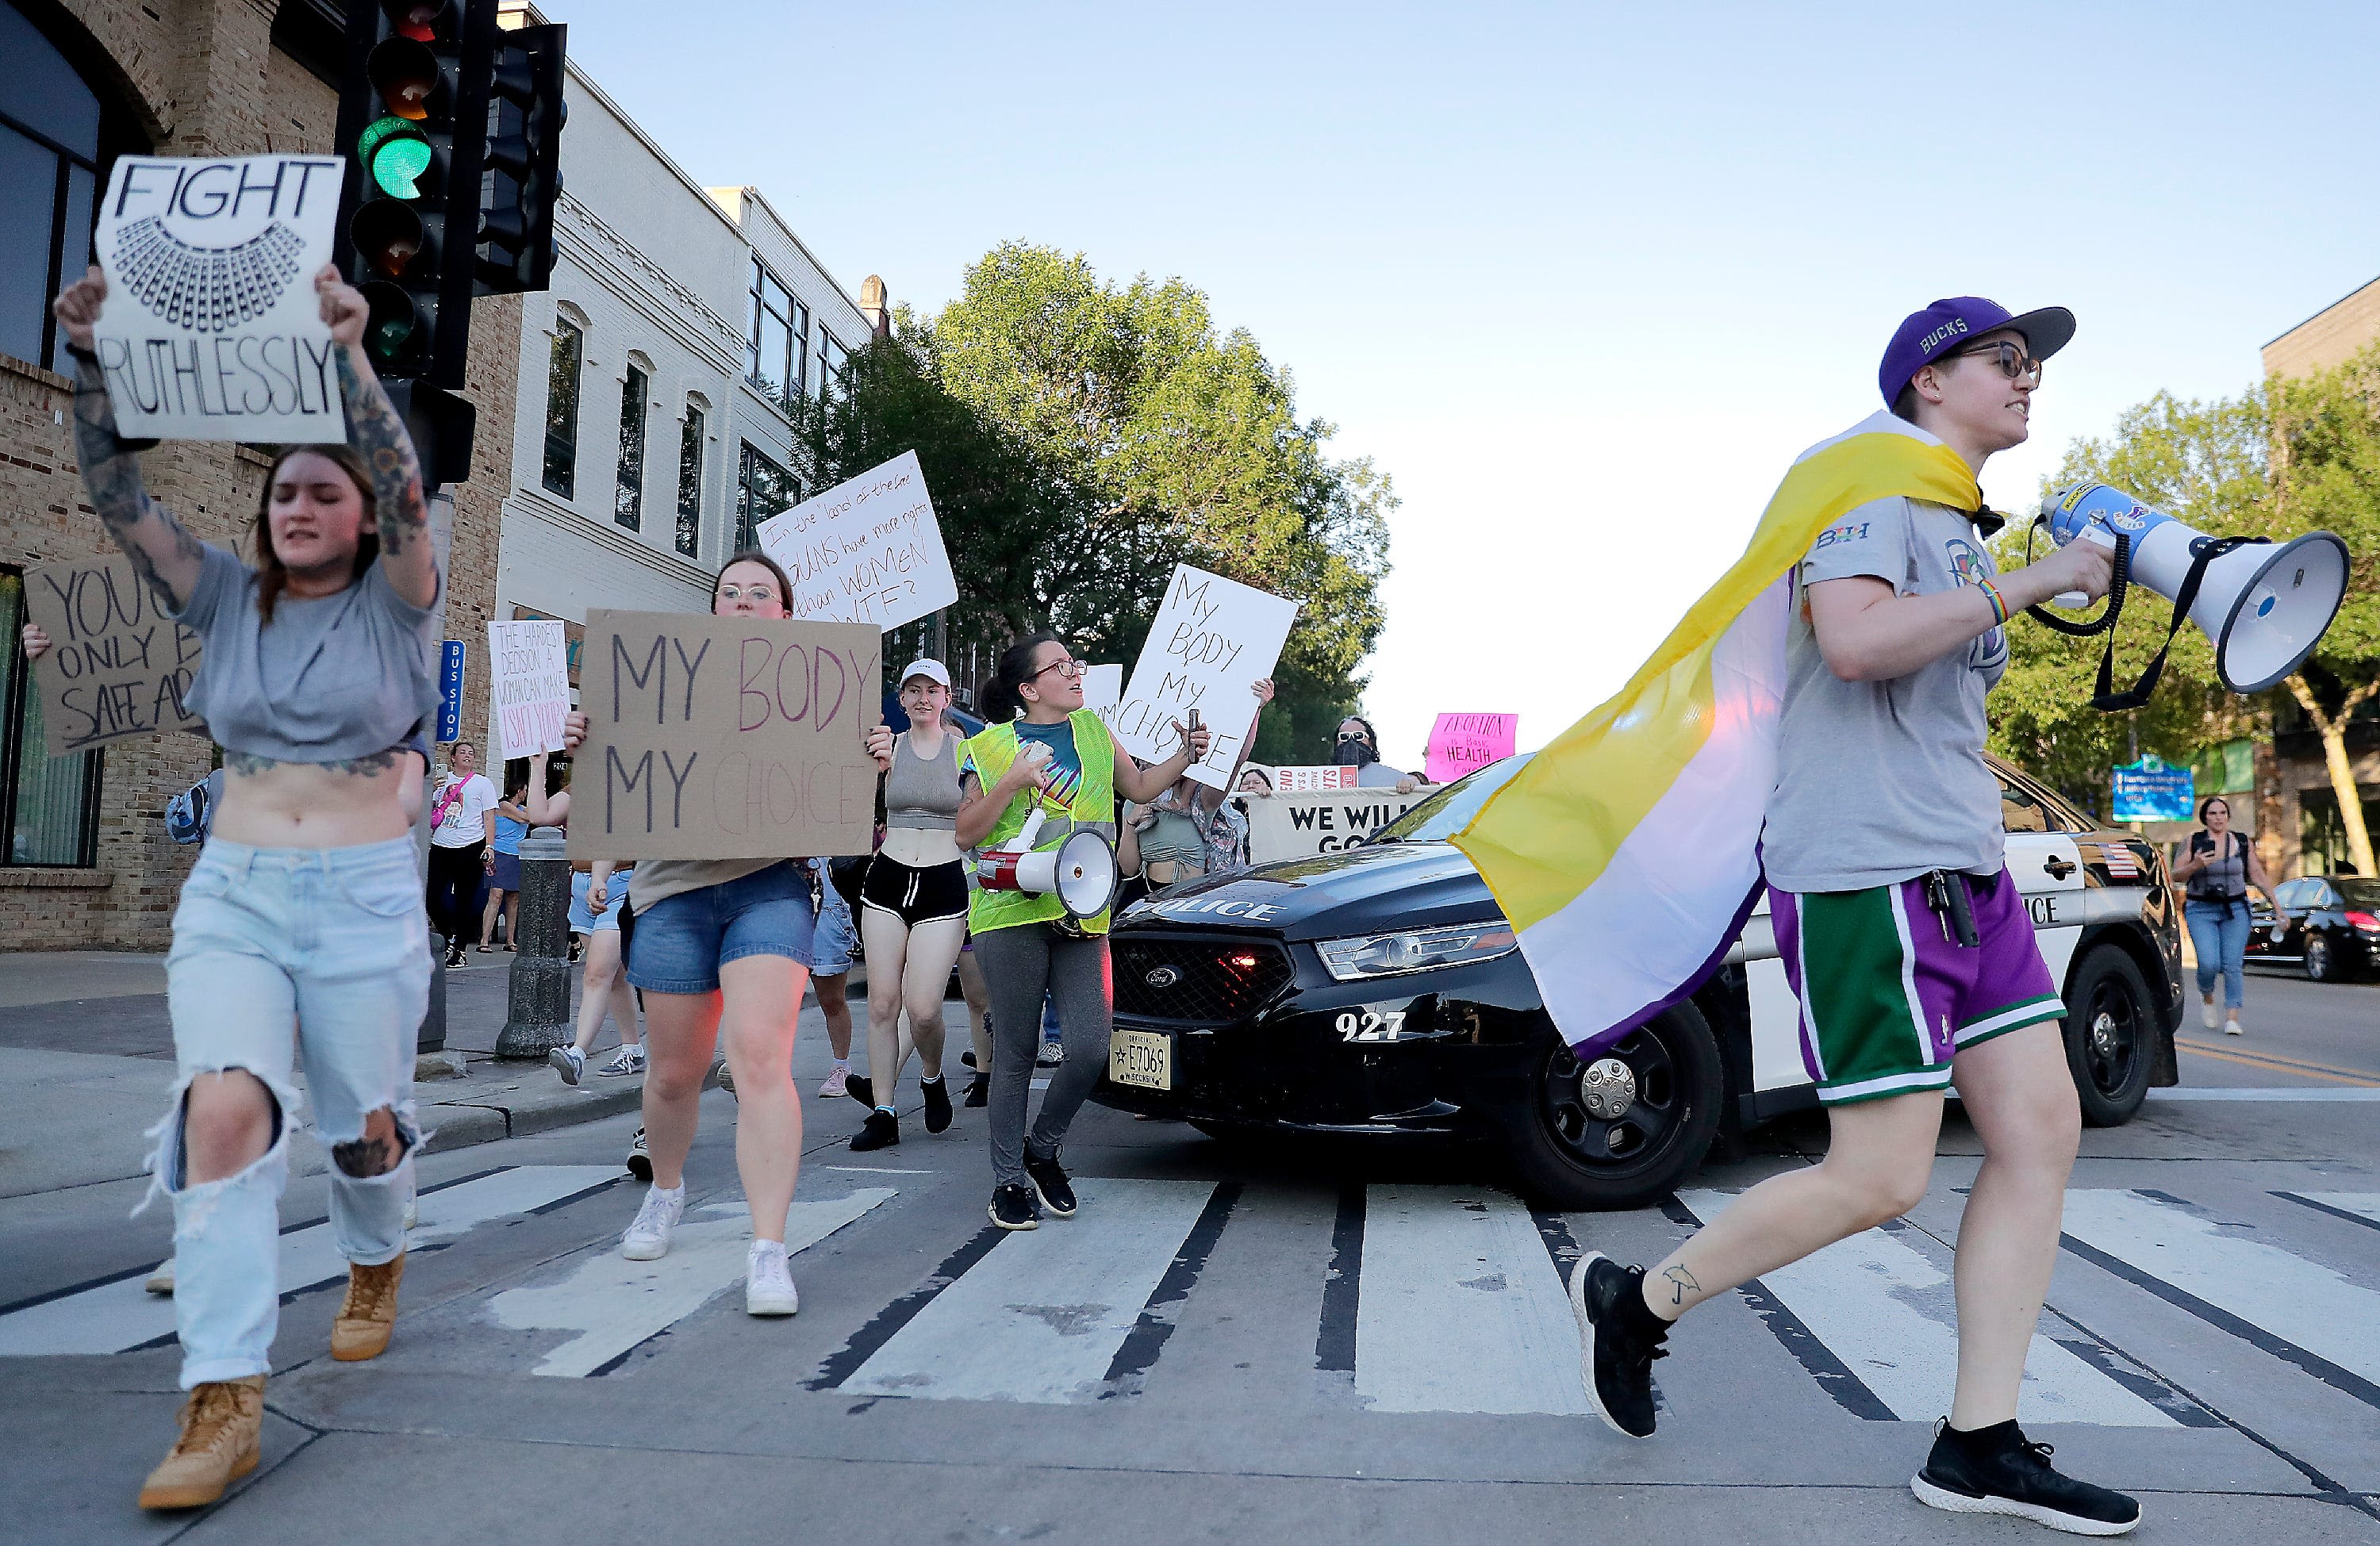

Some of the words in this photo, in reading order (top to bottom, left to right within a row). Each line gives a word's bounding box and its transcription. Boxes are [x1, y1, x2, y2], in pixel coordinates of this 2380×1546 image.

[114, 161, 336, 218] FIGHT
[1920, 317, 1967, 355] BUCKS
[99, 337, 334, 416] RUTHLESSLY
[765, 523, 792, 548] In
[794, 513, 816, 532] the
[856, 486, 869, 508] of
[872, 480, 893, 497] the
[780, 535, 839, 588] GUNS
[839, 533, 869, 556] have
[873, 517, 900, 540] more
[902, 502, 928, 537] rights
[794, 589, 835, 618] than
[838, 536, 928, 596] WOMEN
[57, 626, 155, 679] ONLY
[497, 624, 519, 651] THE
[524, 623, 562, 649] HARDEST
[1166, 622, 1243, 673] BODY
[451, 646, 459, 681] BUS
[501, 649, 541, 676] DECISION
[547, 648, 555, 668] A
[543, 670, 565, 700] MAKE
[612, 634, 712, 725] MY
[739, 637, 878, 739] BODY
[61, 681, 145, 741] SAFE
[447, 689, 457, 737] STOP
[1444, 715, 1507, 737] ABORTION
[1446, 746, 1491, 762] HEALTH
[606, 745, 698, 834] MY
[713, 751, 866, 835] CHOICE
[1289, 806, 1334, 831] WE
[1123, 898, 1288, 922] POLICE
[1335, 1011, 1406, 1042] 927
[1125, 1072, 1155, 1084] WISCONSIN
[1129, 1045, 1164, 1074] E7069
